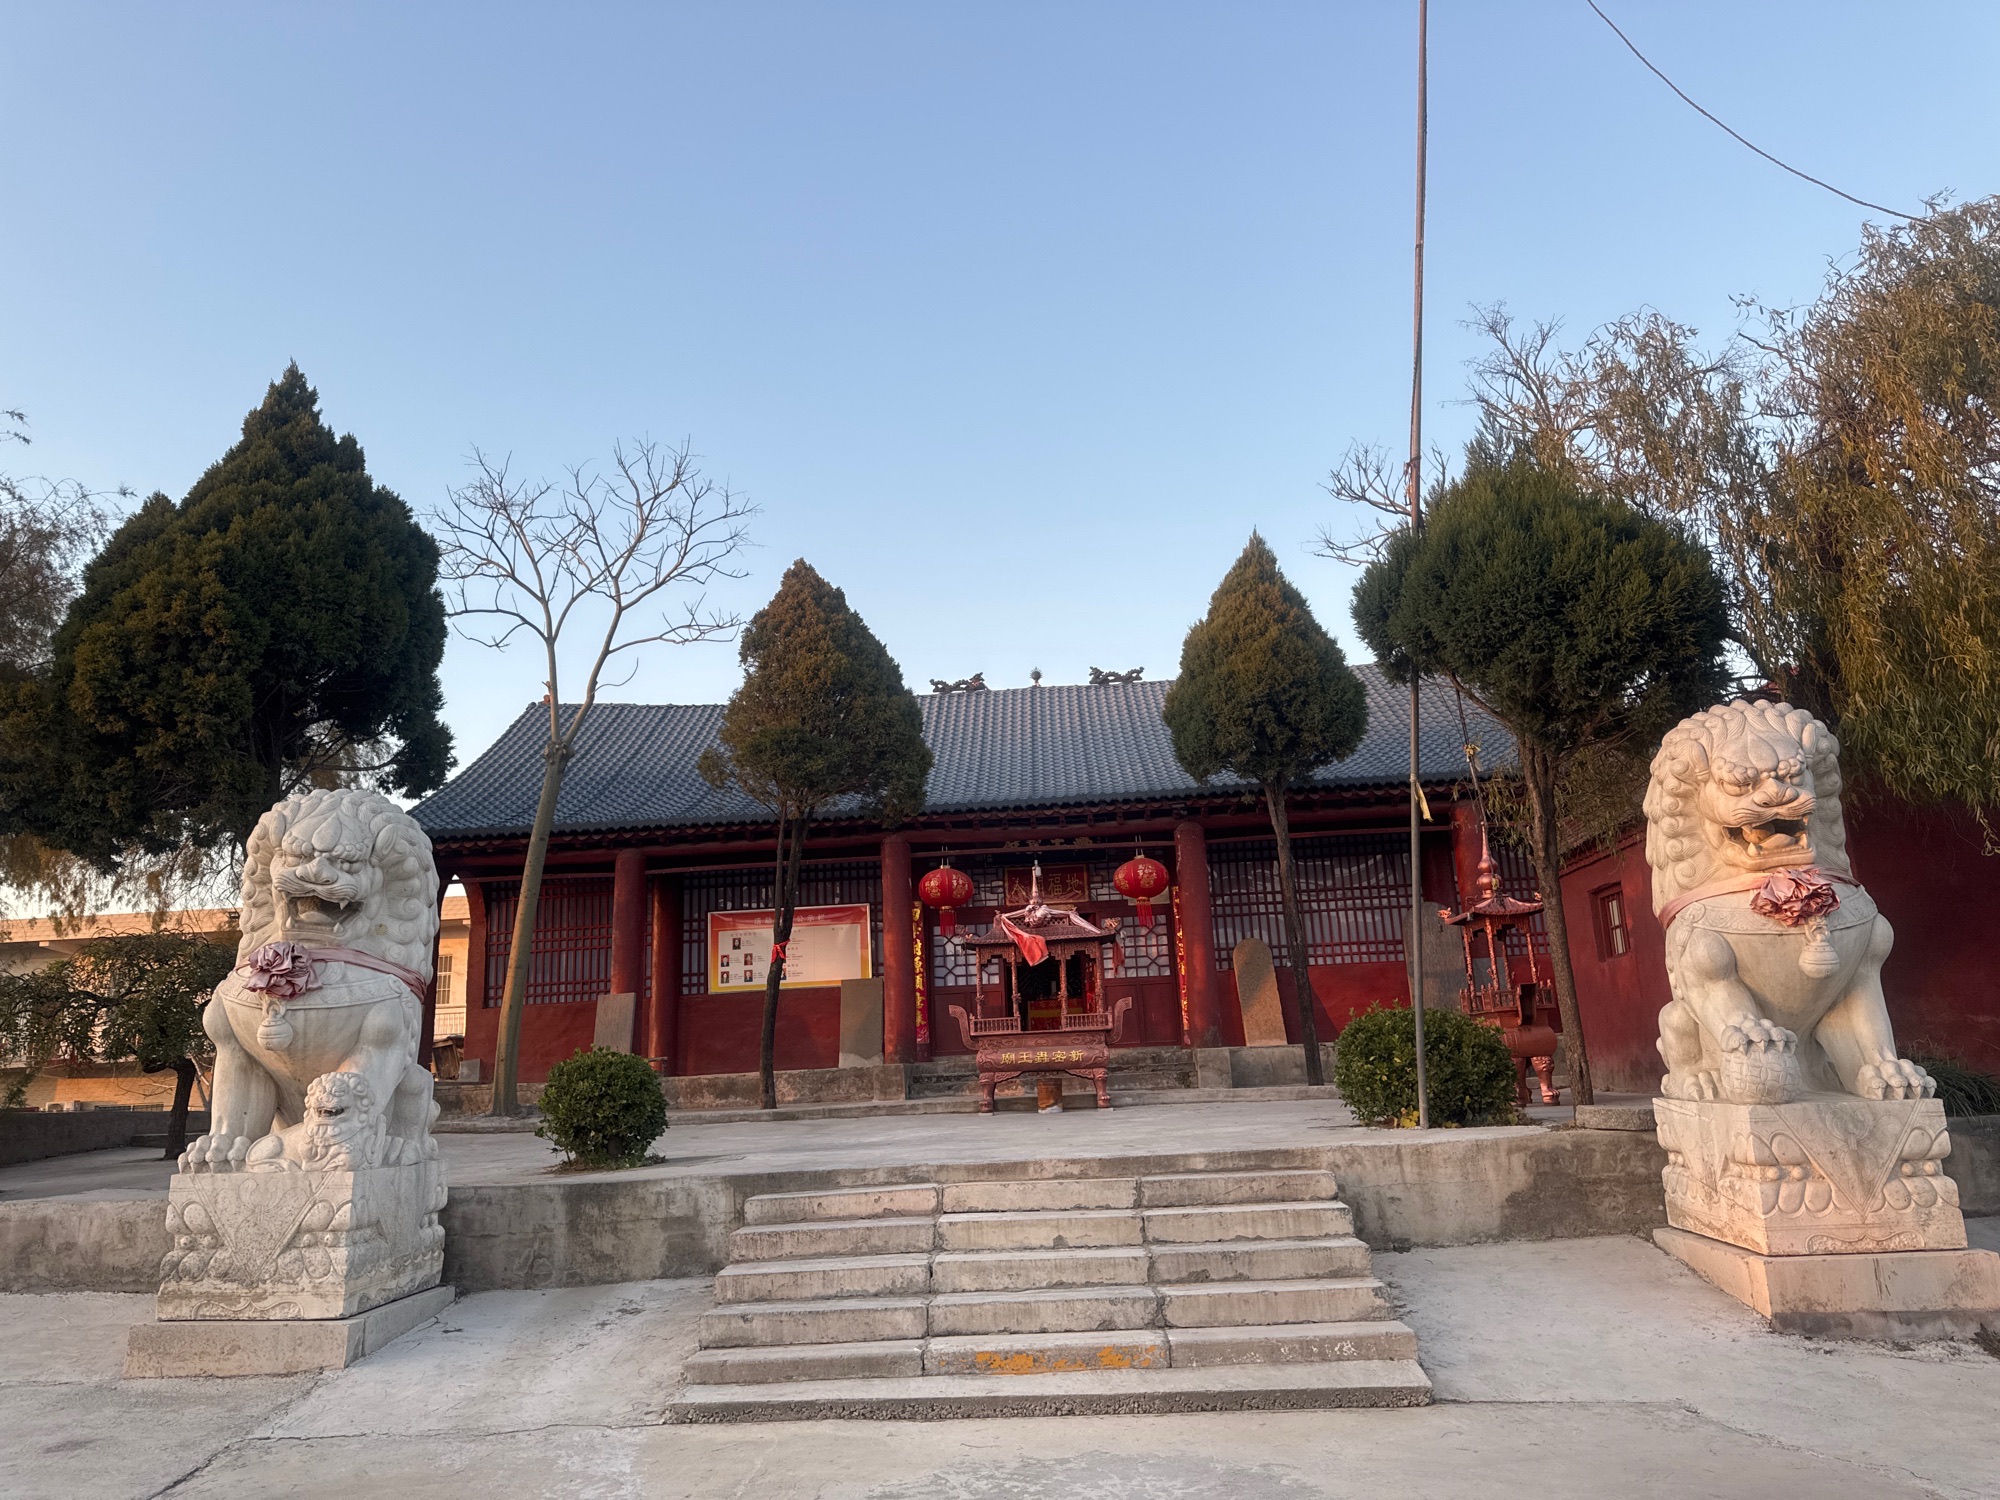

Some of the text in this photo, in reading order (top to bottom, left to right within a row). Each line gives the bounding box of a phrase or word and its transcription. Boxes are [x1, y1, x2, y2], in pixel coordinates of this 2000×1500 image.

[754, 913, 825, 925] 活动公示栏
